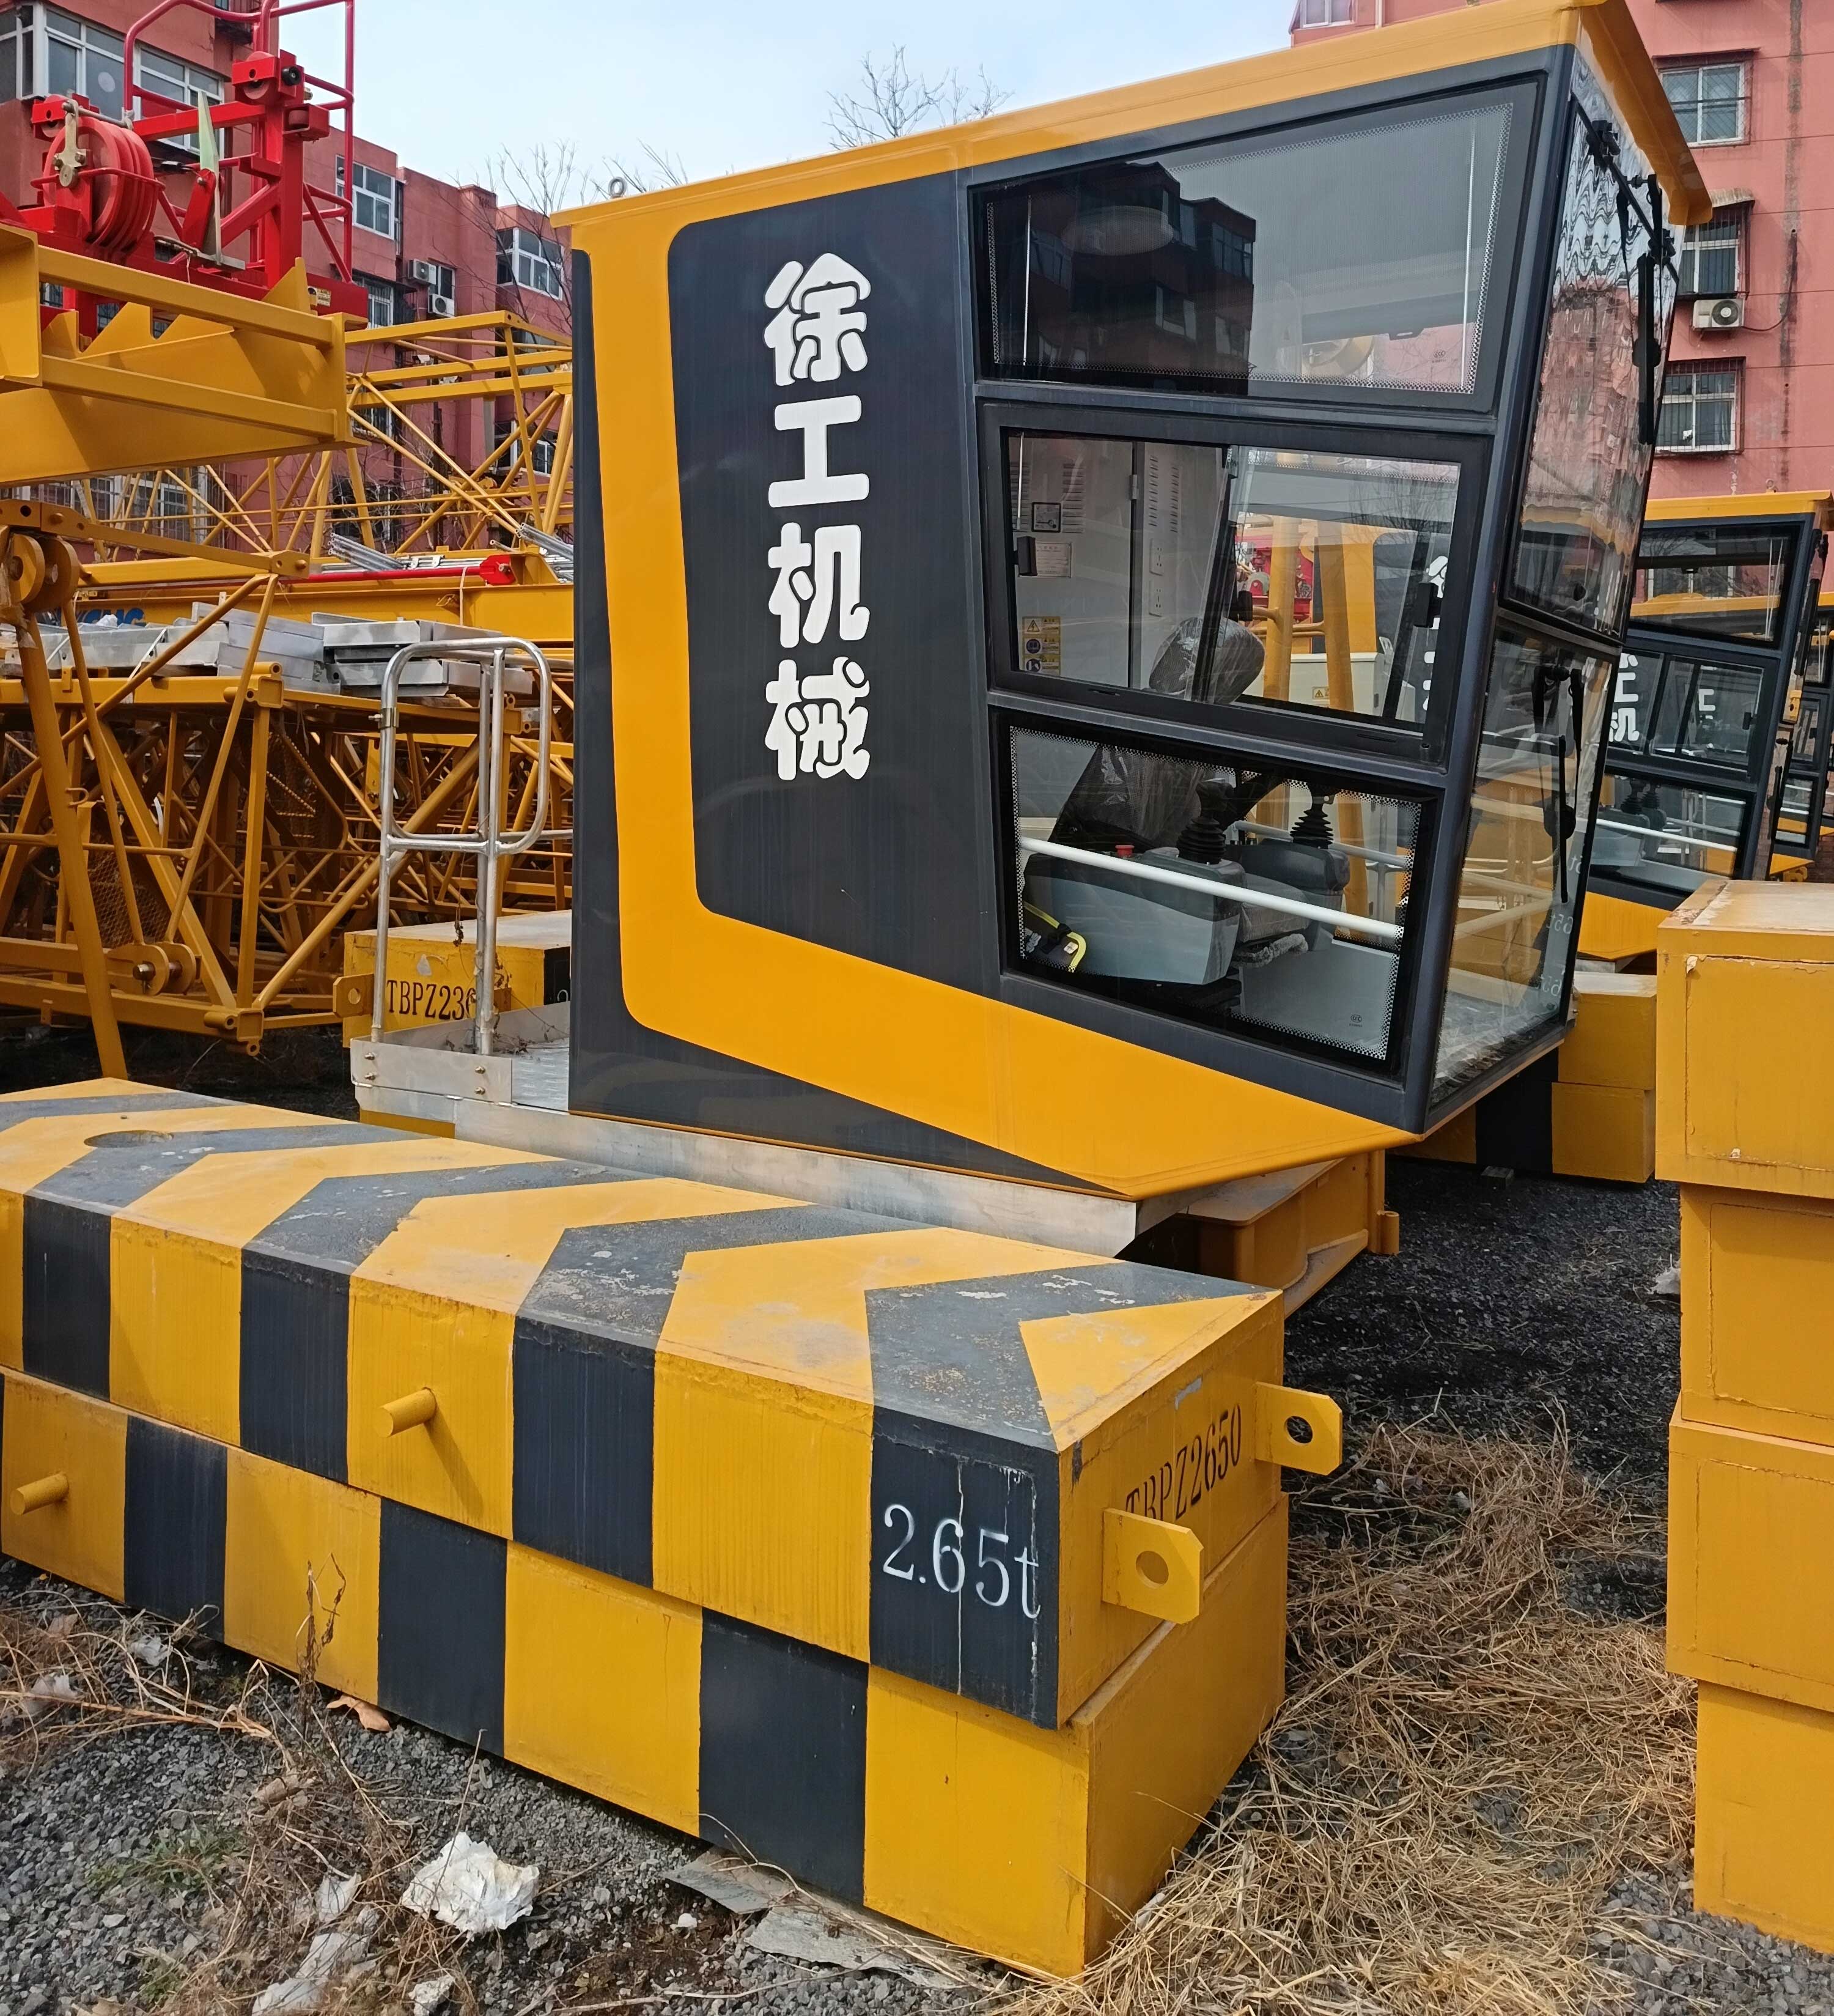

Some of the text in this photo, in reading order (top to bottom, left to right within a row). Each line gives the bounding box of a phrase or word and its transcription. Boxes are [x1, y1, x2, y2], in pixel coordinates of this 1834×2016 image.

[764, 252, 871, 780] 徐工机械
[883, 1504, 1040, 1619] 2.65t
